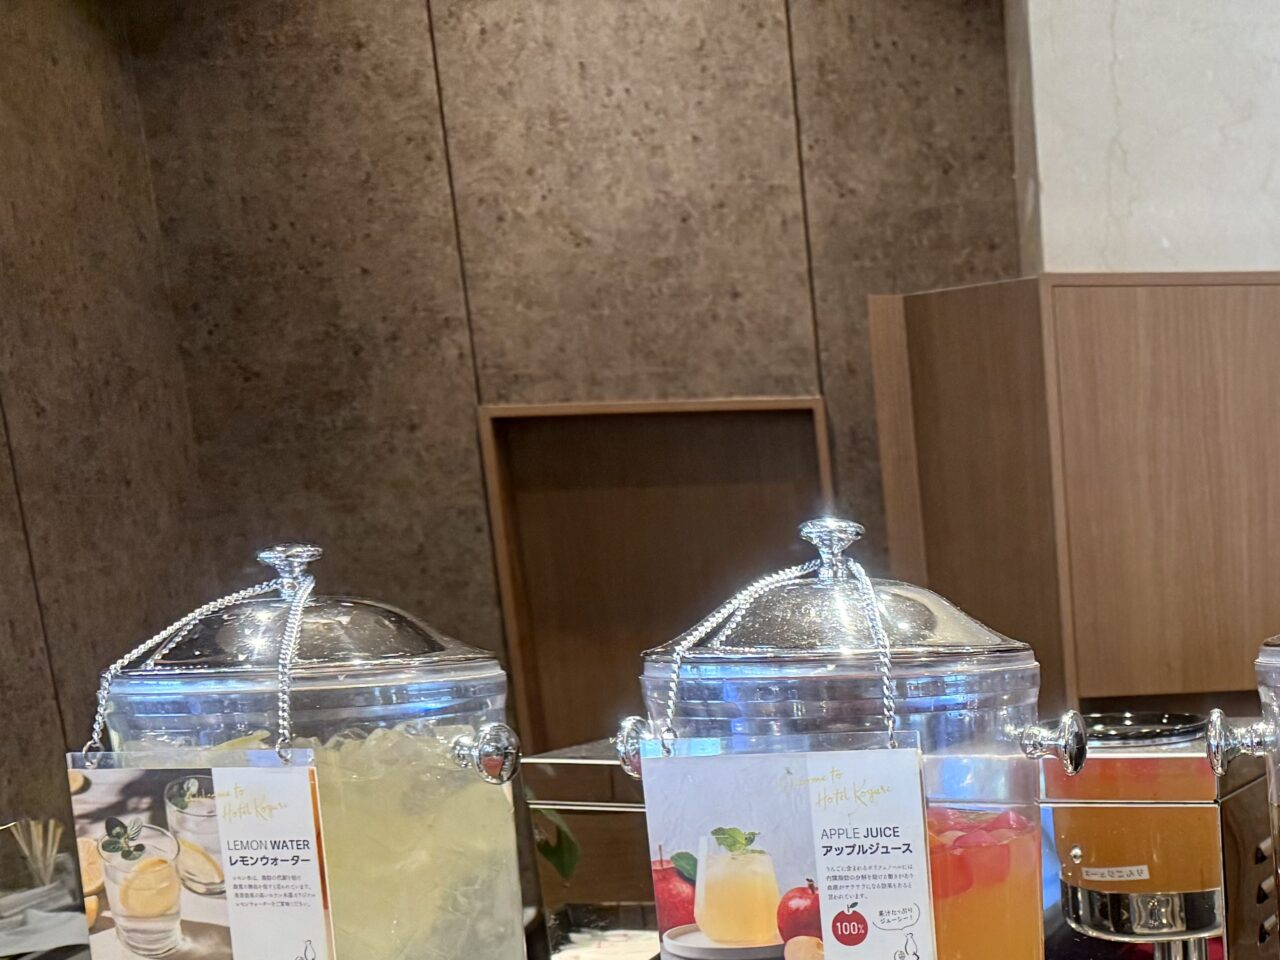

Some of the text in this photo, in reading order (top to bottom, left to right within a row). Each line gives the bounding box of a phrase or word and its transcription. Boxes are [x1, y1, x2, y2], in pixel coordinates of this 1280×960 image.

[821, 826, 900, 840] APPLE JUICE
[227, 839, 311, 851] LEMON WATER
[821, 842, 914, 857] アップルジュース
[229, 855, 311, 867] レモンウォーター
[836, 921, 865, 935] 100%
